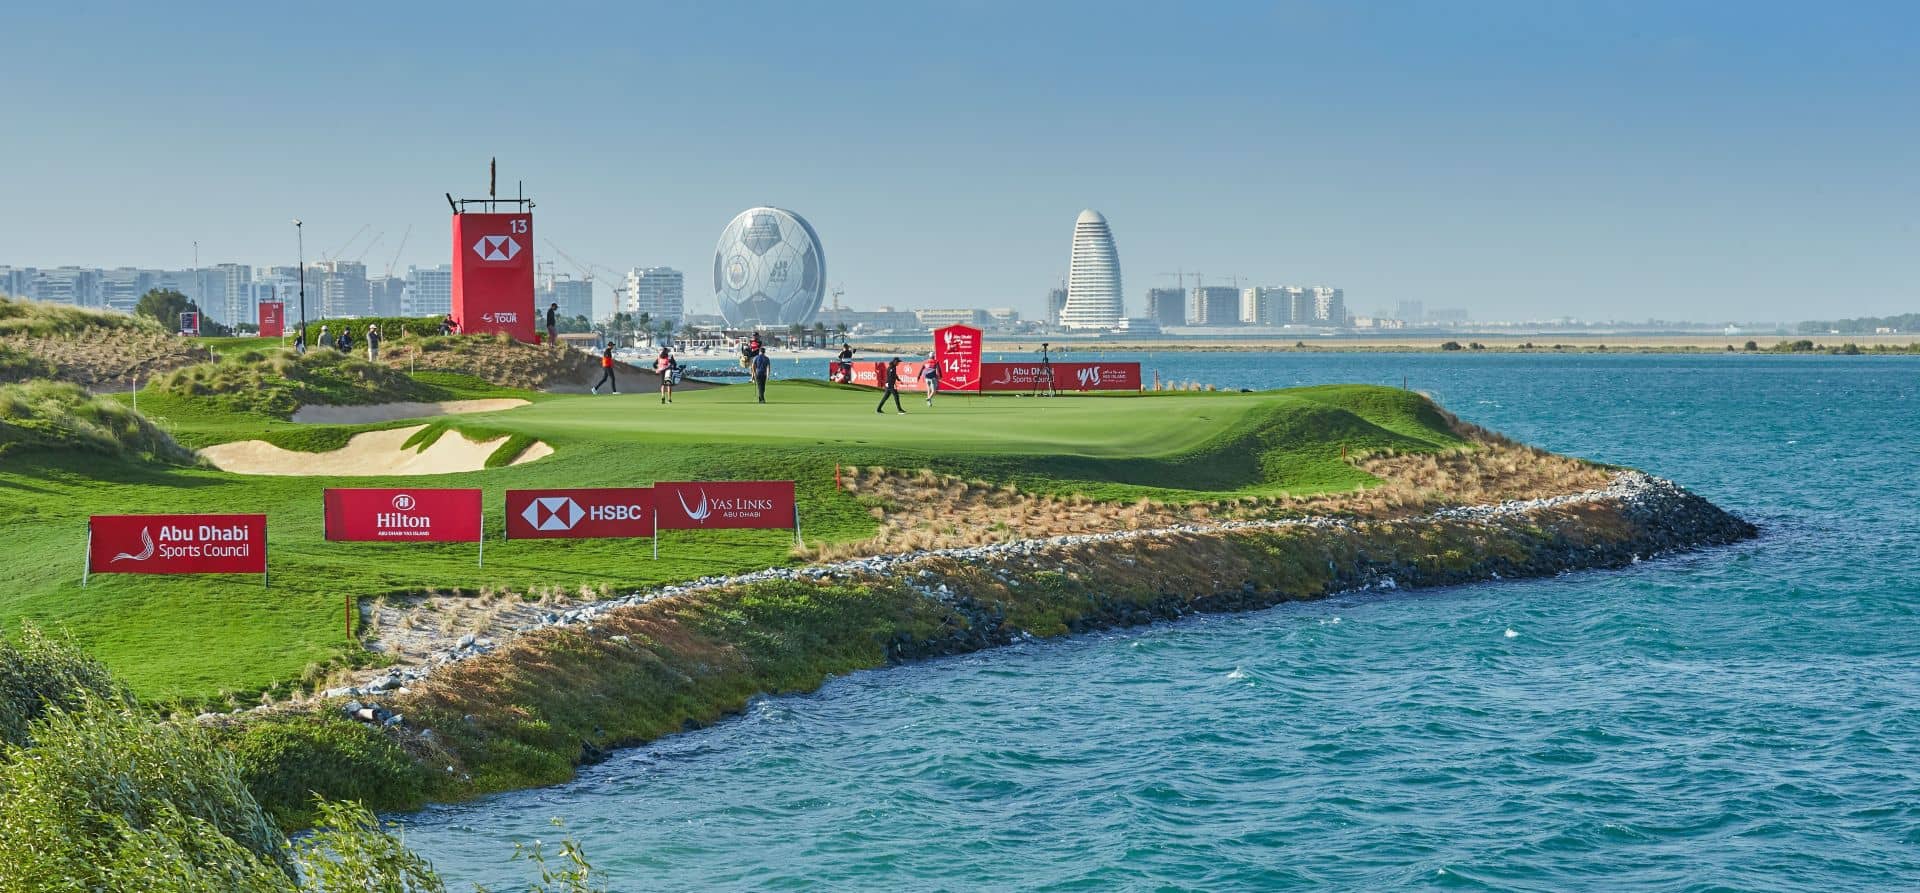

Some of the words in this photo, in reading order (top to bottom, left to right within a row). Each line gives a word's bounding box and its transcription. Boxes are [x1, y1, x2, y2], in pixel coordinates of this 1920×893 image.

[509, 219, 528, 234] 13
[943, 359, 960, 373] 14
[1012, 367, 1029, 375] Abu
[858, 371, 877, 380] HSBC
[1012, 375, 1032, 384] Sports
[710, 498, 733, 510] YAS
[736, 498, 772, 510] LINKS
[590, 505, 641, 520] HSBC
[376, 512, 431, 528] Hilton
[159, 525, 193, 541] Abu
[199, 525, 249, 541] Dhabi
[159, 543, 200, 559] Sports
[203, 543, 249, 557] Council
